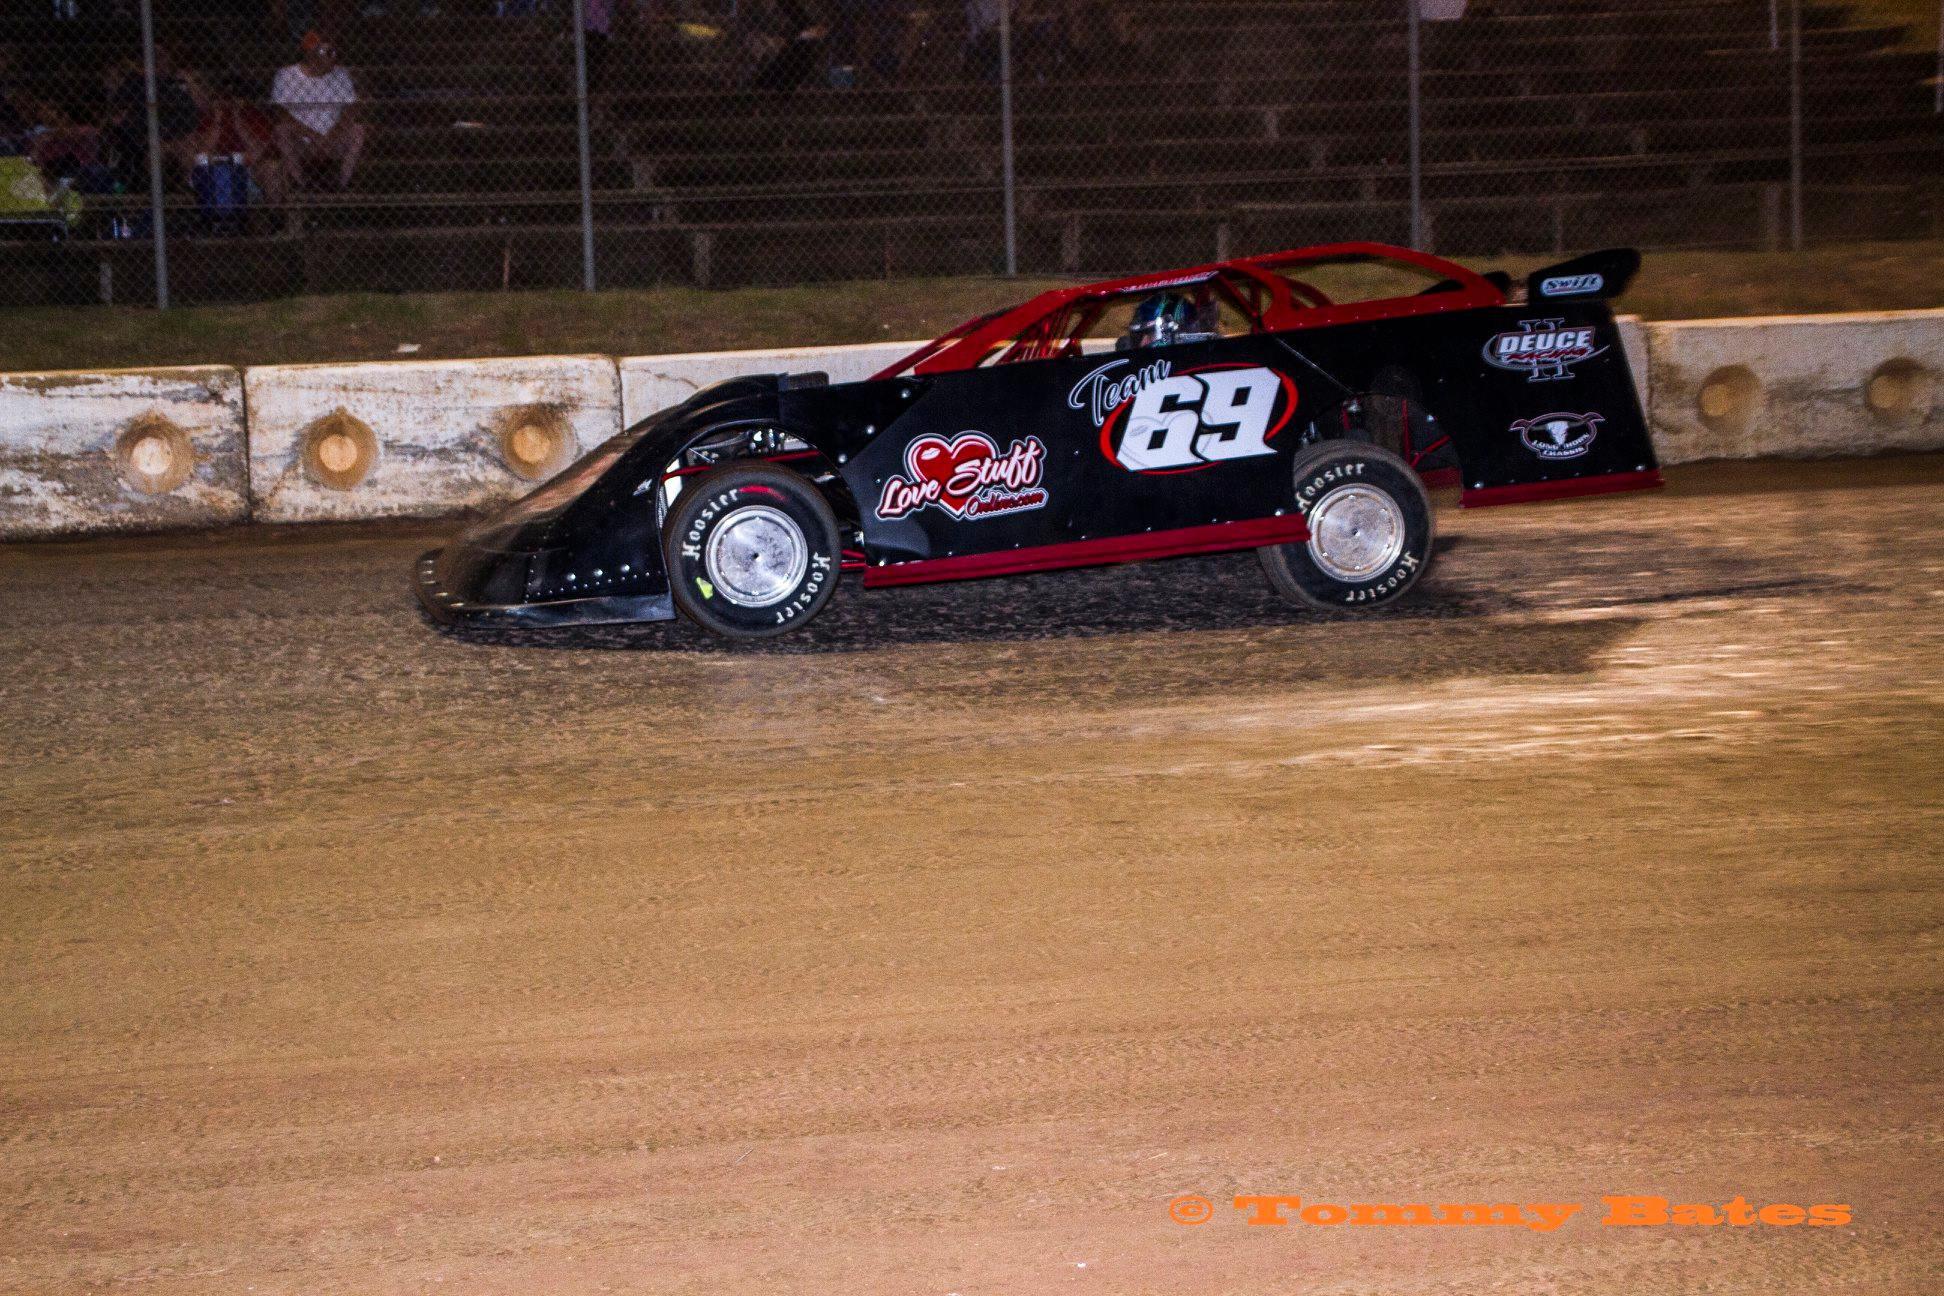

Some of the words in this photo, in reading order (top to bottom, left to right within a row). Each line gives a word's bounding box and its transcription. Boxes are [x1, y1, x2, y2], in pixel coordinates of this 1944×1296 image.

[1546, 274, 1599, 290] Swift
[1499, 330, 1591, 353] DEUCE
[1068, 358, 1171, 427] Team
[1116, 366, 1278, 473] 69
[880, 480, 942, 515] Love
[946, 439, 1041, 496] Stuff
[1294, 462, 1366, 514] Hoosier
[682, 487, 739, 562] Hoosier
[775, 551, 832, 624] Hoosier
[1345, 550, 1420, 602] Hoosier
